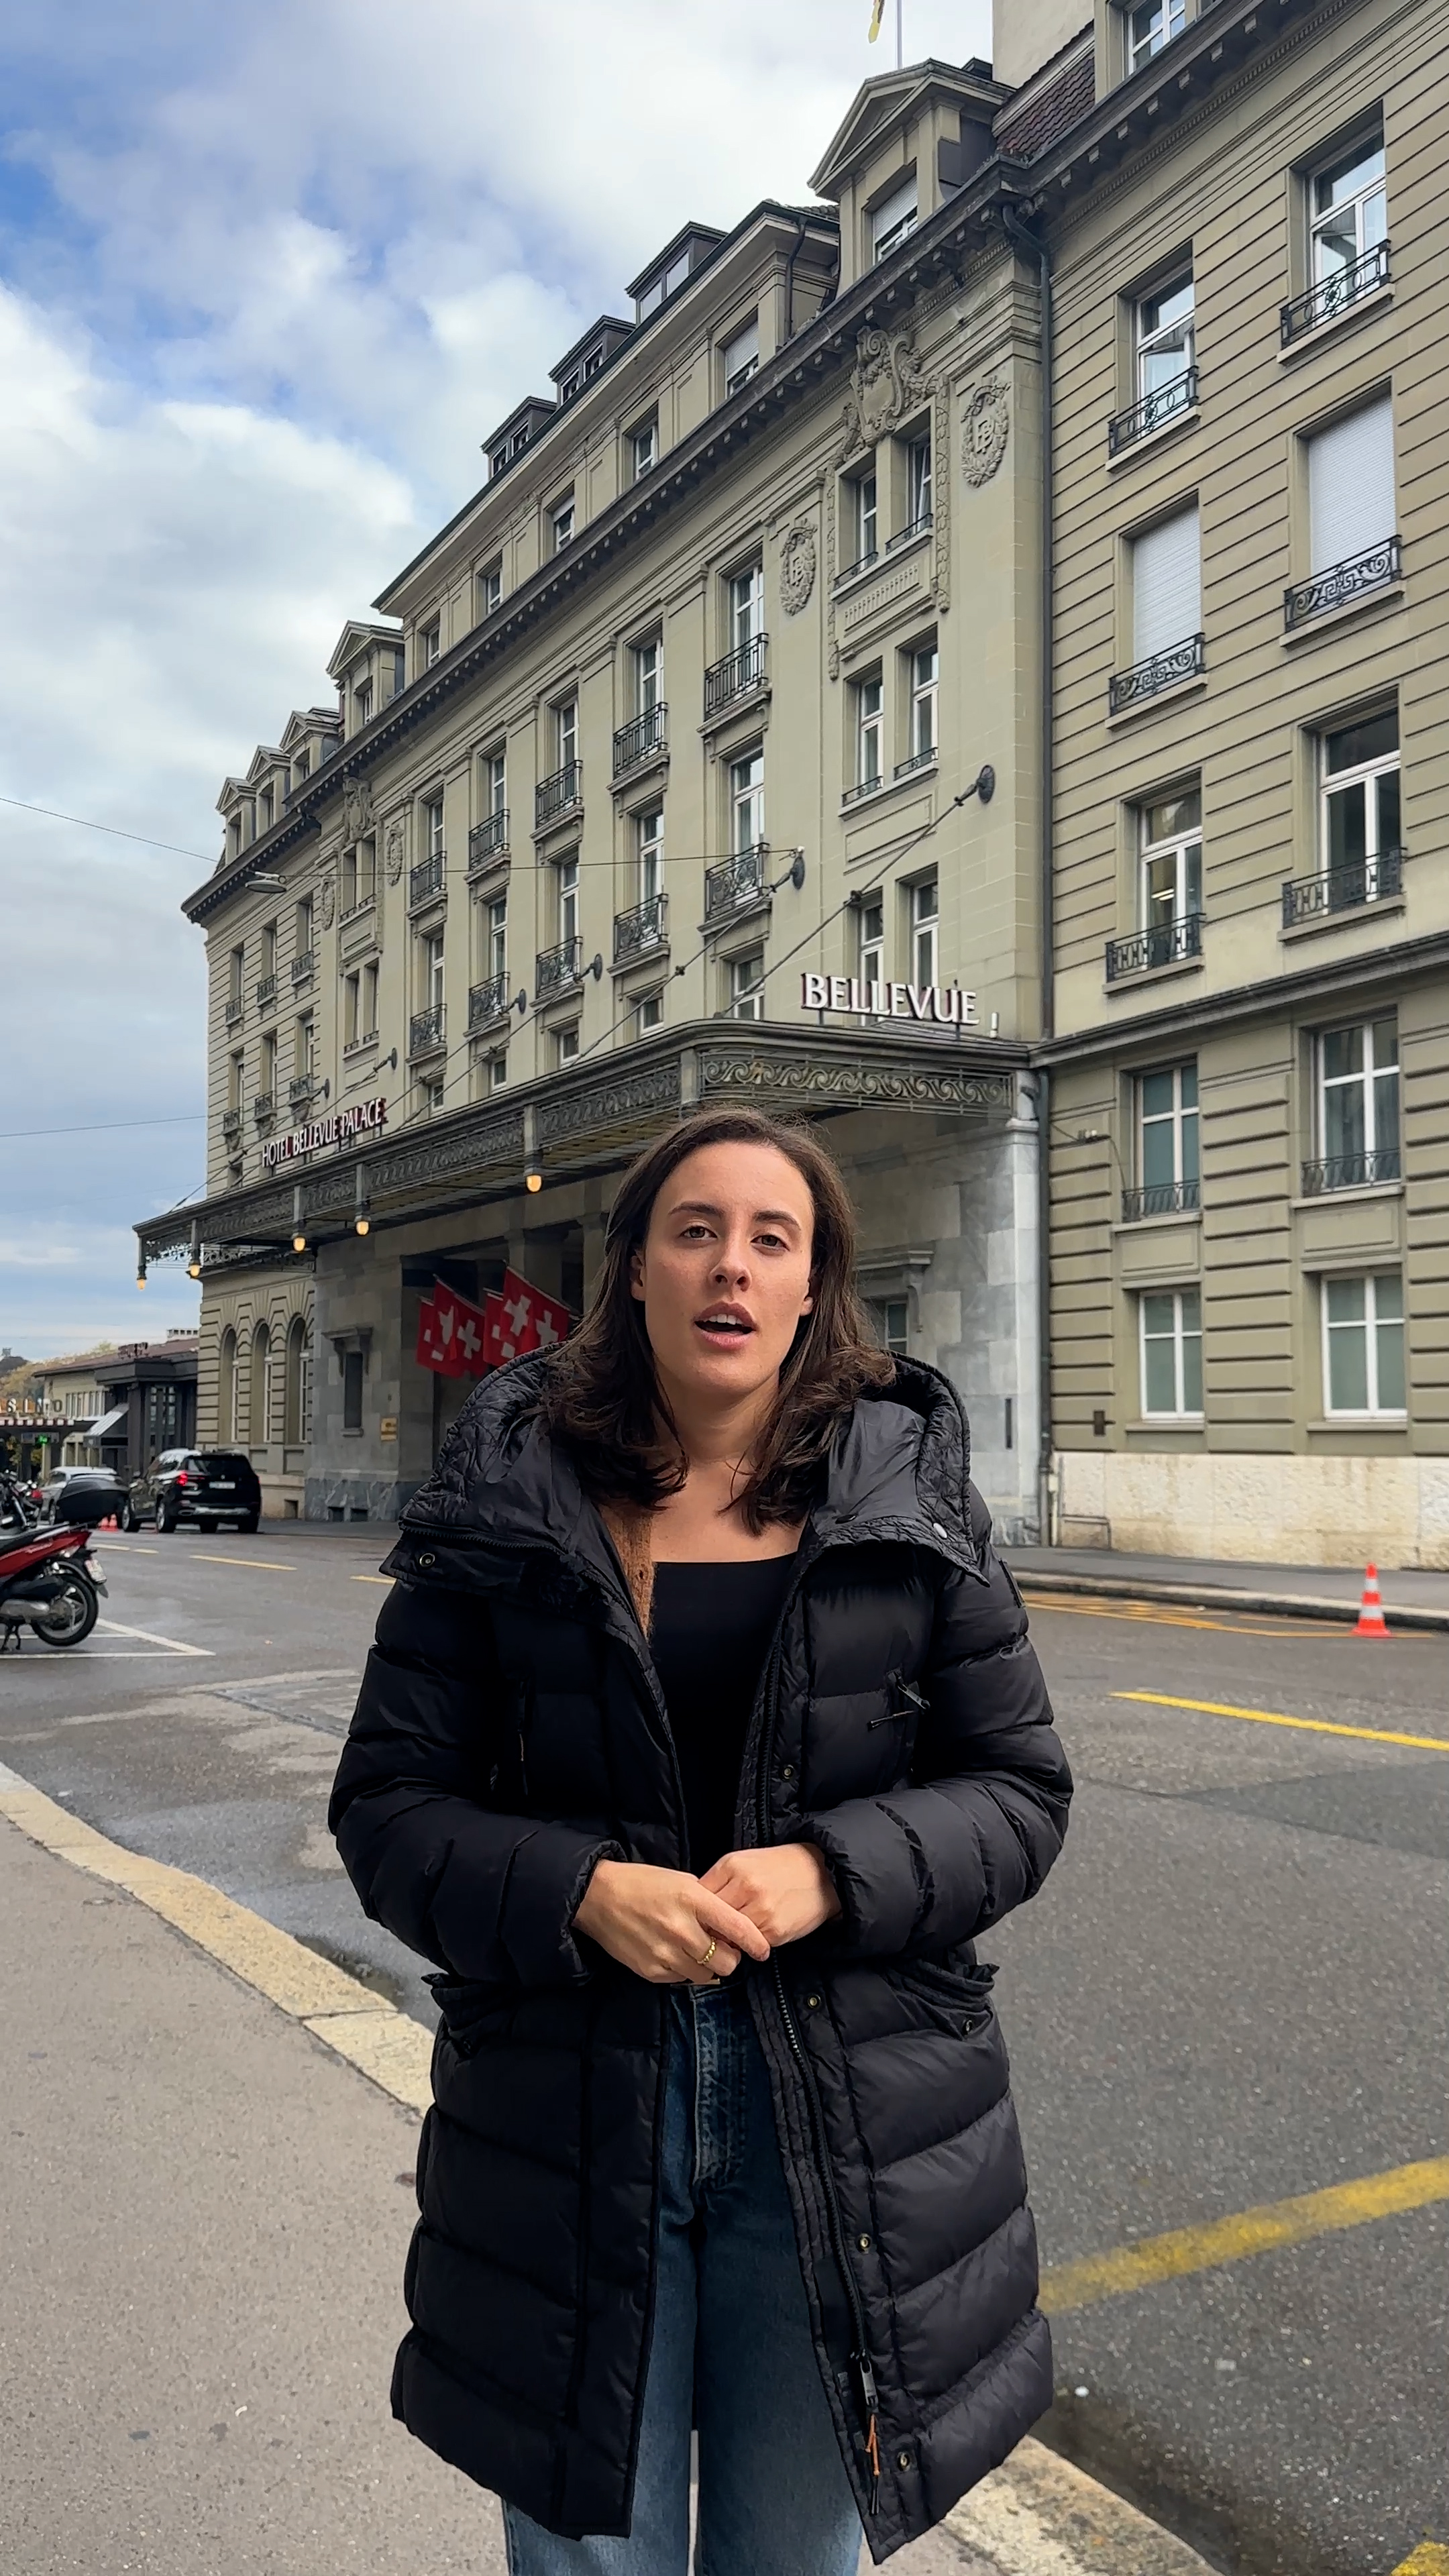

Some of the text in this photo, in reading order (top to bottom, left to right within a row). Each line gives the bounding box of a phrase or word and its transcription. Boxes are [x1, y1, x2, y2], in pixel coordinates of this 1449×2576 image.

[802, 973, 980, 1024] BELLEVUE
[262, 1097, 383, 1168] HOTEL BELLEVUE PALACE
